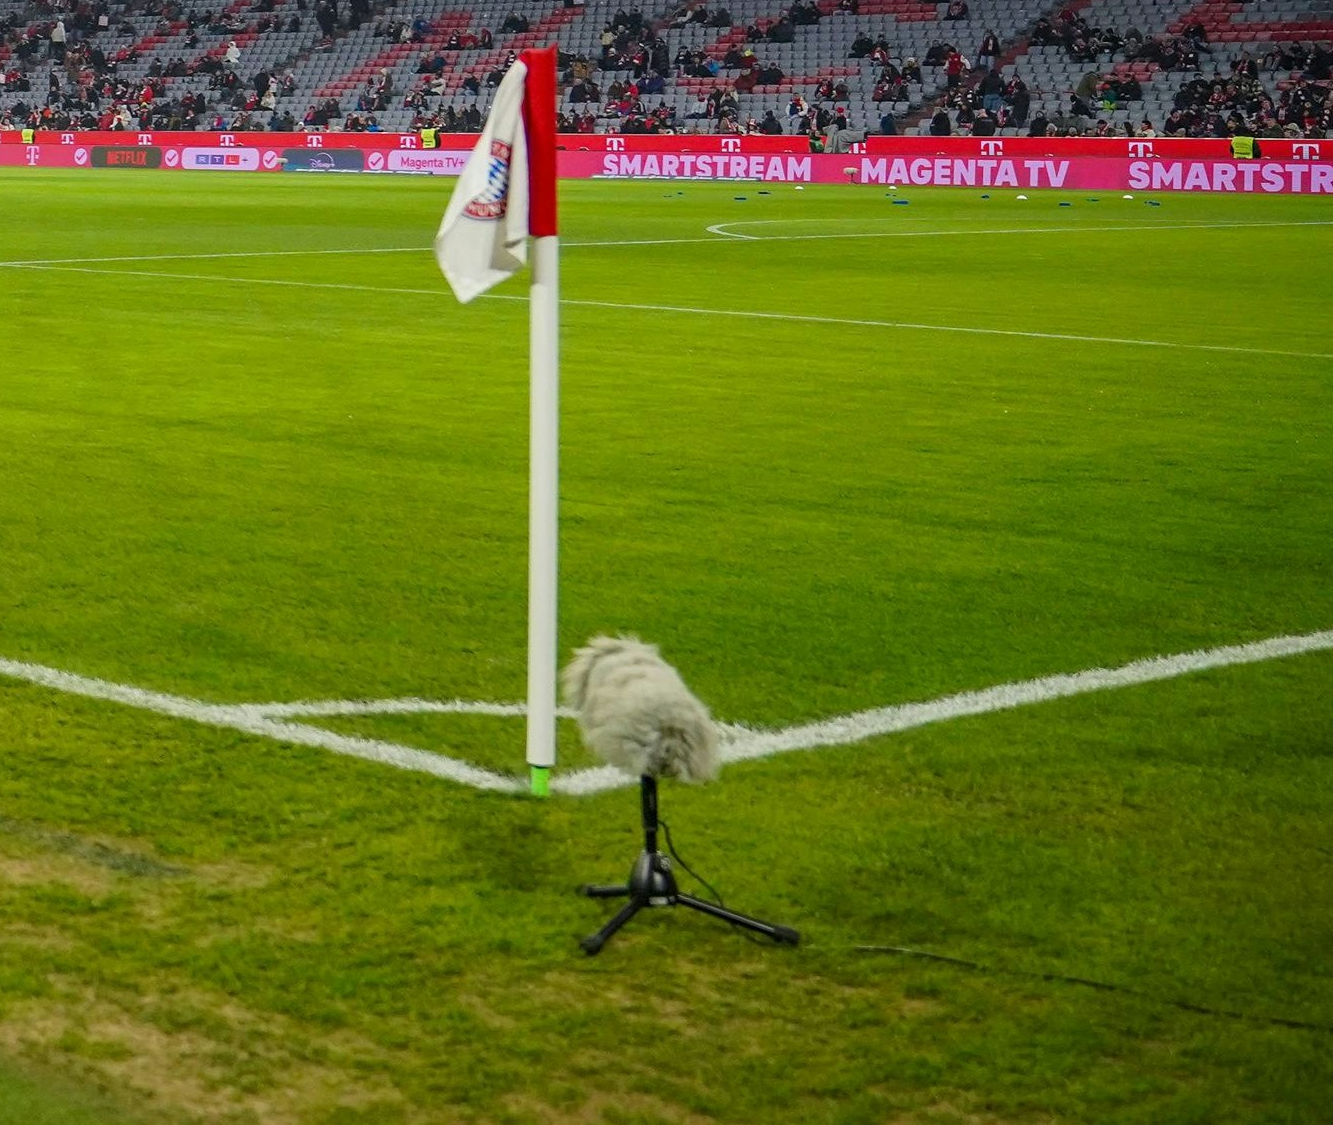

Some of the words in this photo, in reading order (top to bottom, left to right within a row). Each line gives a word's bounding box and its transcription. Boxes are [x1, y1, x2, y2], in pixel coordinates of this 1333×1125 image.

[106, 150, 147, 166] NETFLIX
[400, 155, 445, 170] Magenta
[445, 158, 465, 168] TV+
[603, 153, 813, 182] SMARTSTREAM
[860, 156, 1019, 187] MAGENTA
[1024, 160, 1071, 188] TV
